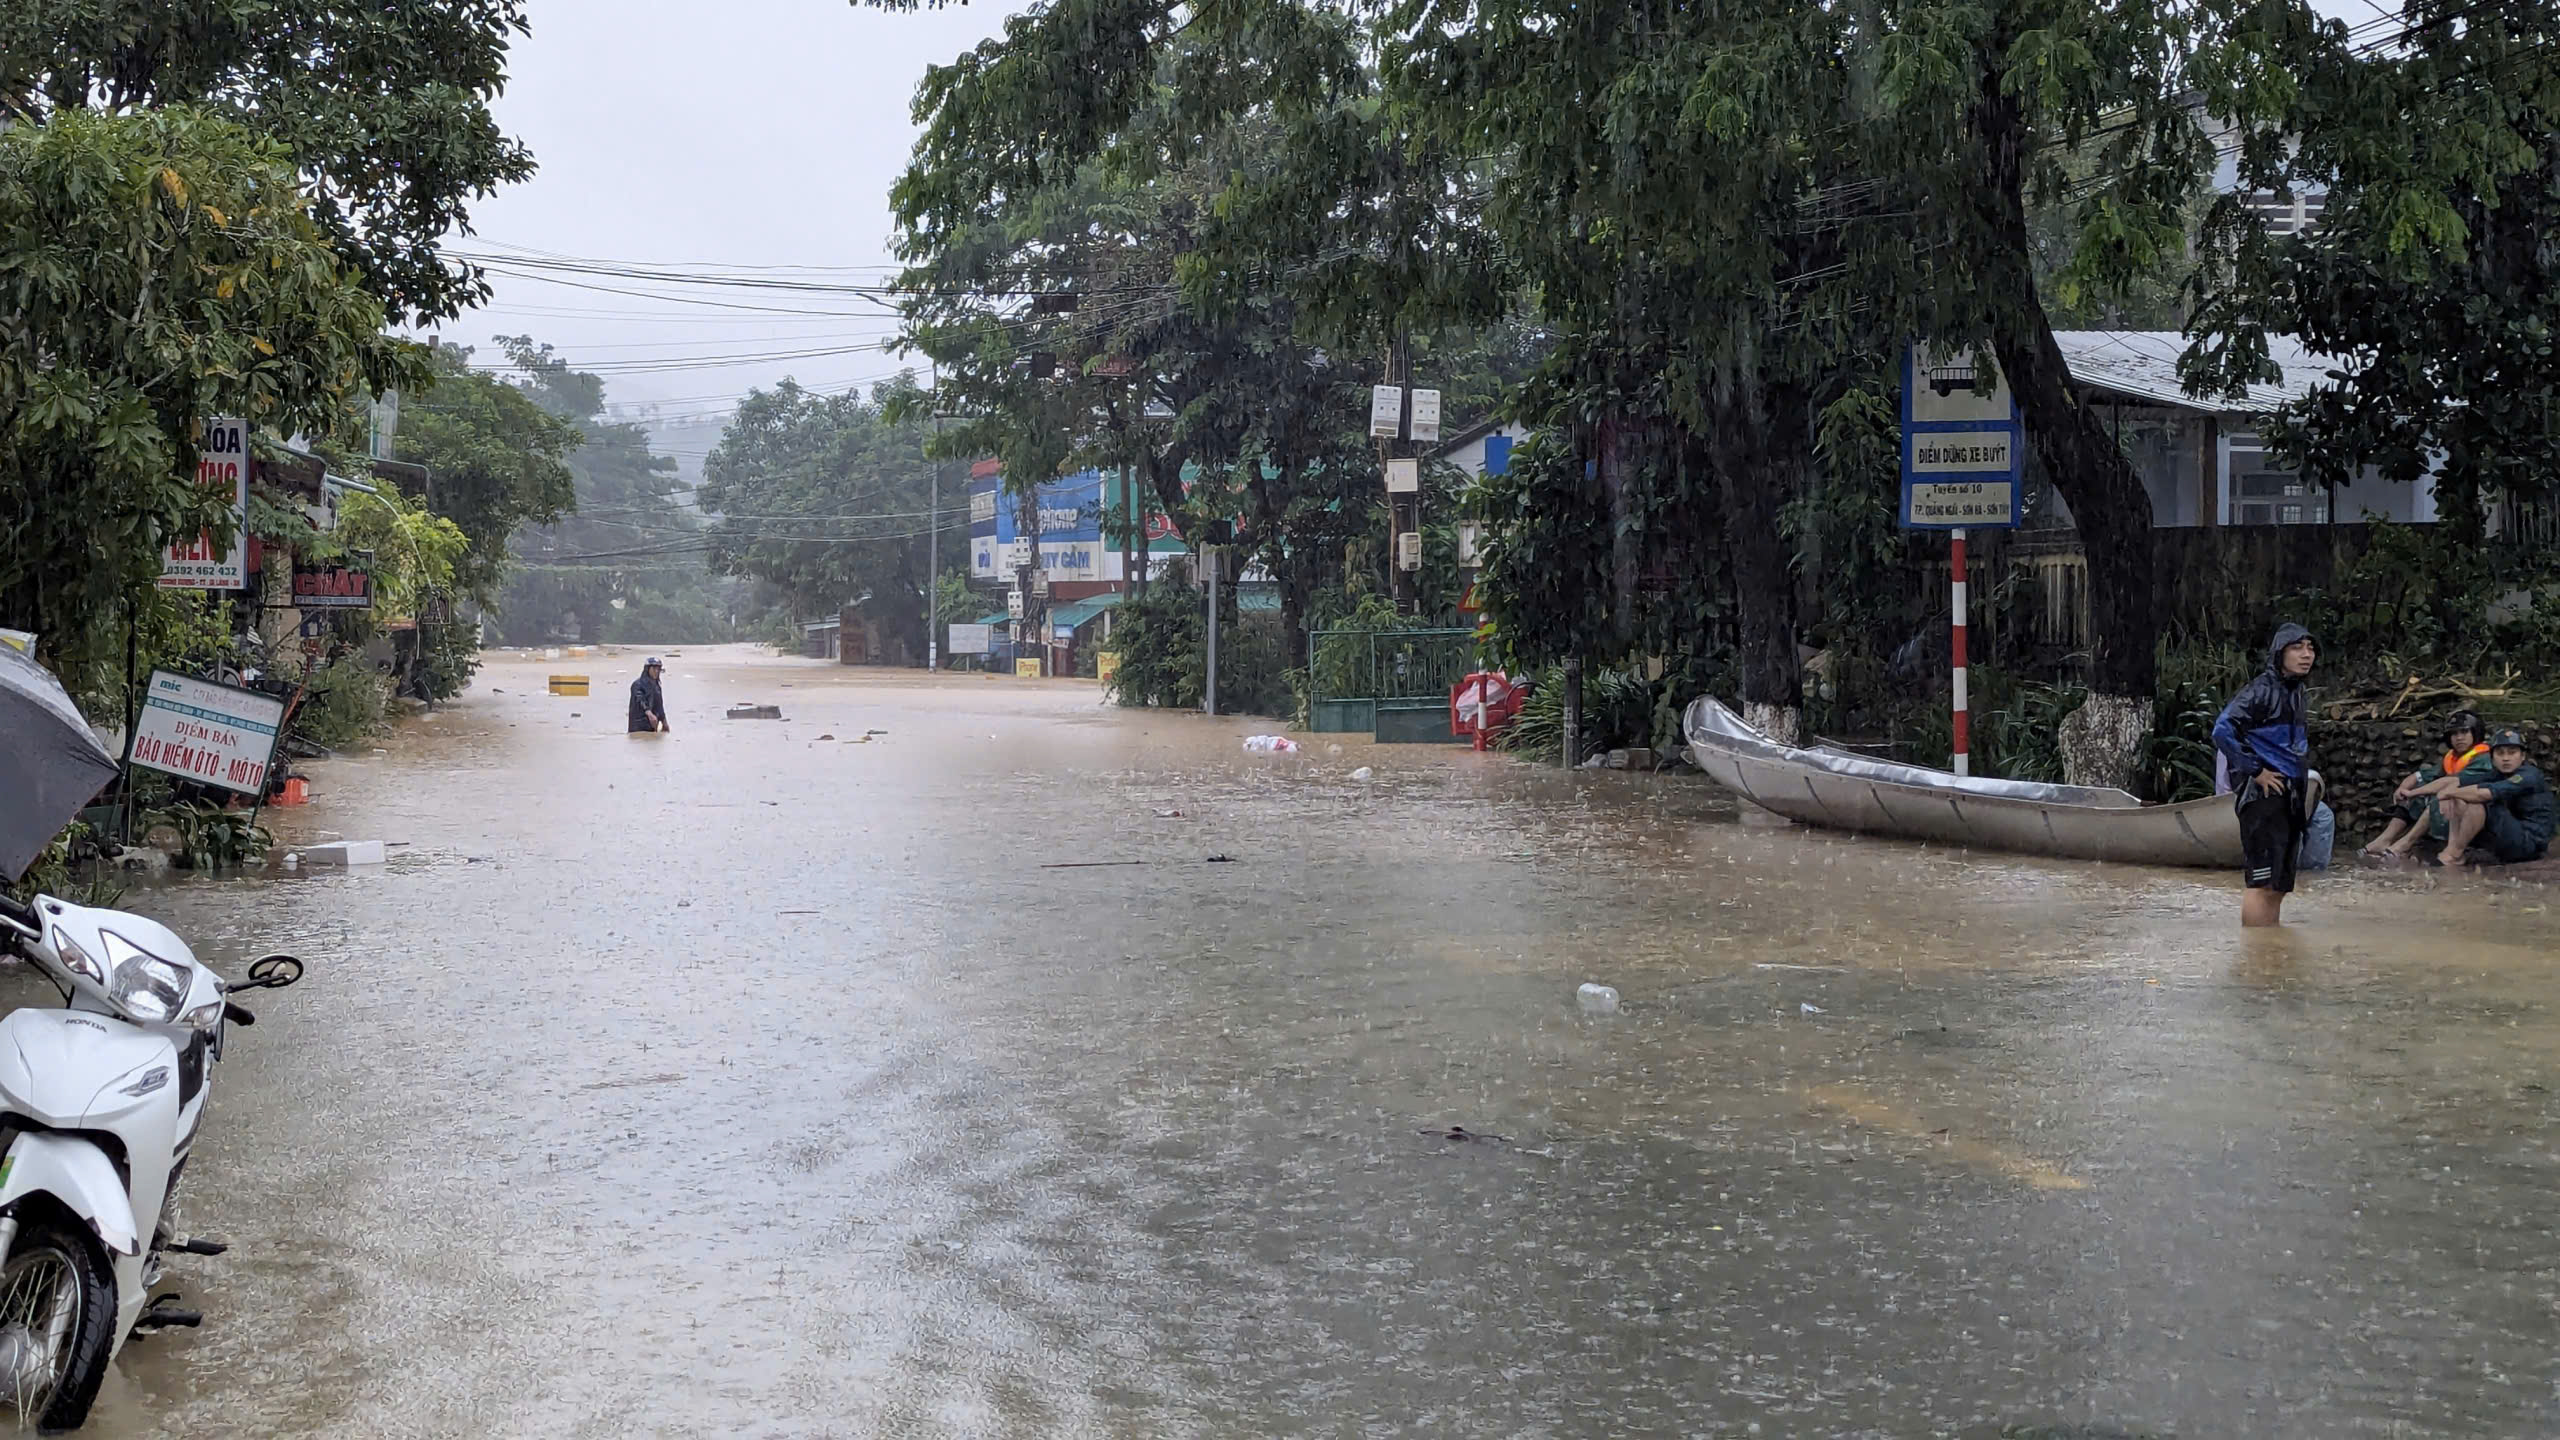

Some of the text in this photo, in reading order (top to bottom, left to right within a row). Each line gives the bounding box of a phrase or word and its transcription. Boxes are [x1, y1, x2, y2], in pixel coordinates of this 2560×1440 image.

[1918, 440, 2006, 464] ĐIỂM DỪNG XE BUÝT
[1932, 484, 1957, 495] Tuyến
[1971, 483, 1982, 494] 10
[159, 679, 183, 693] mic
[175, 720, 239, 747] ĐIỂM BÁN
[134, 731, 161, 763] BẢO
[160, 737, 195, 771] HIỂM
[194, 745, 220, 777] ÔTÔ
[226, 757, 264, 787] MÔTÔ
[64, 1018, 108, 1033] HONDA
